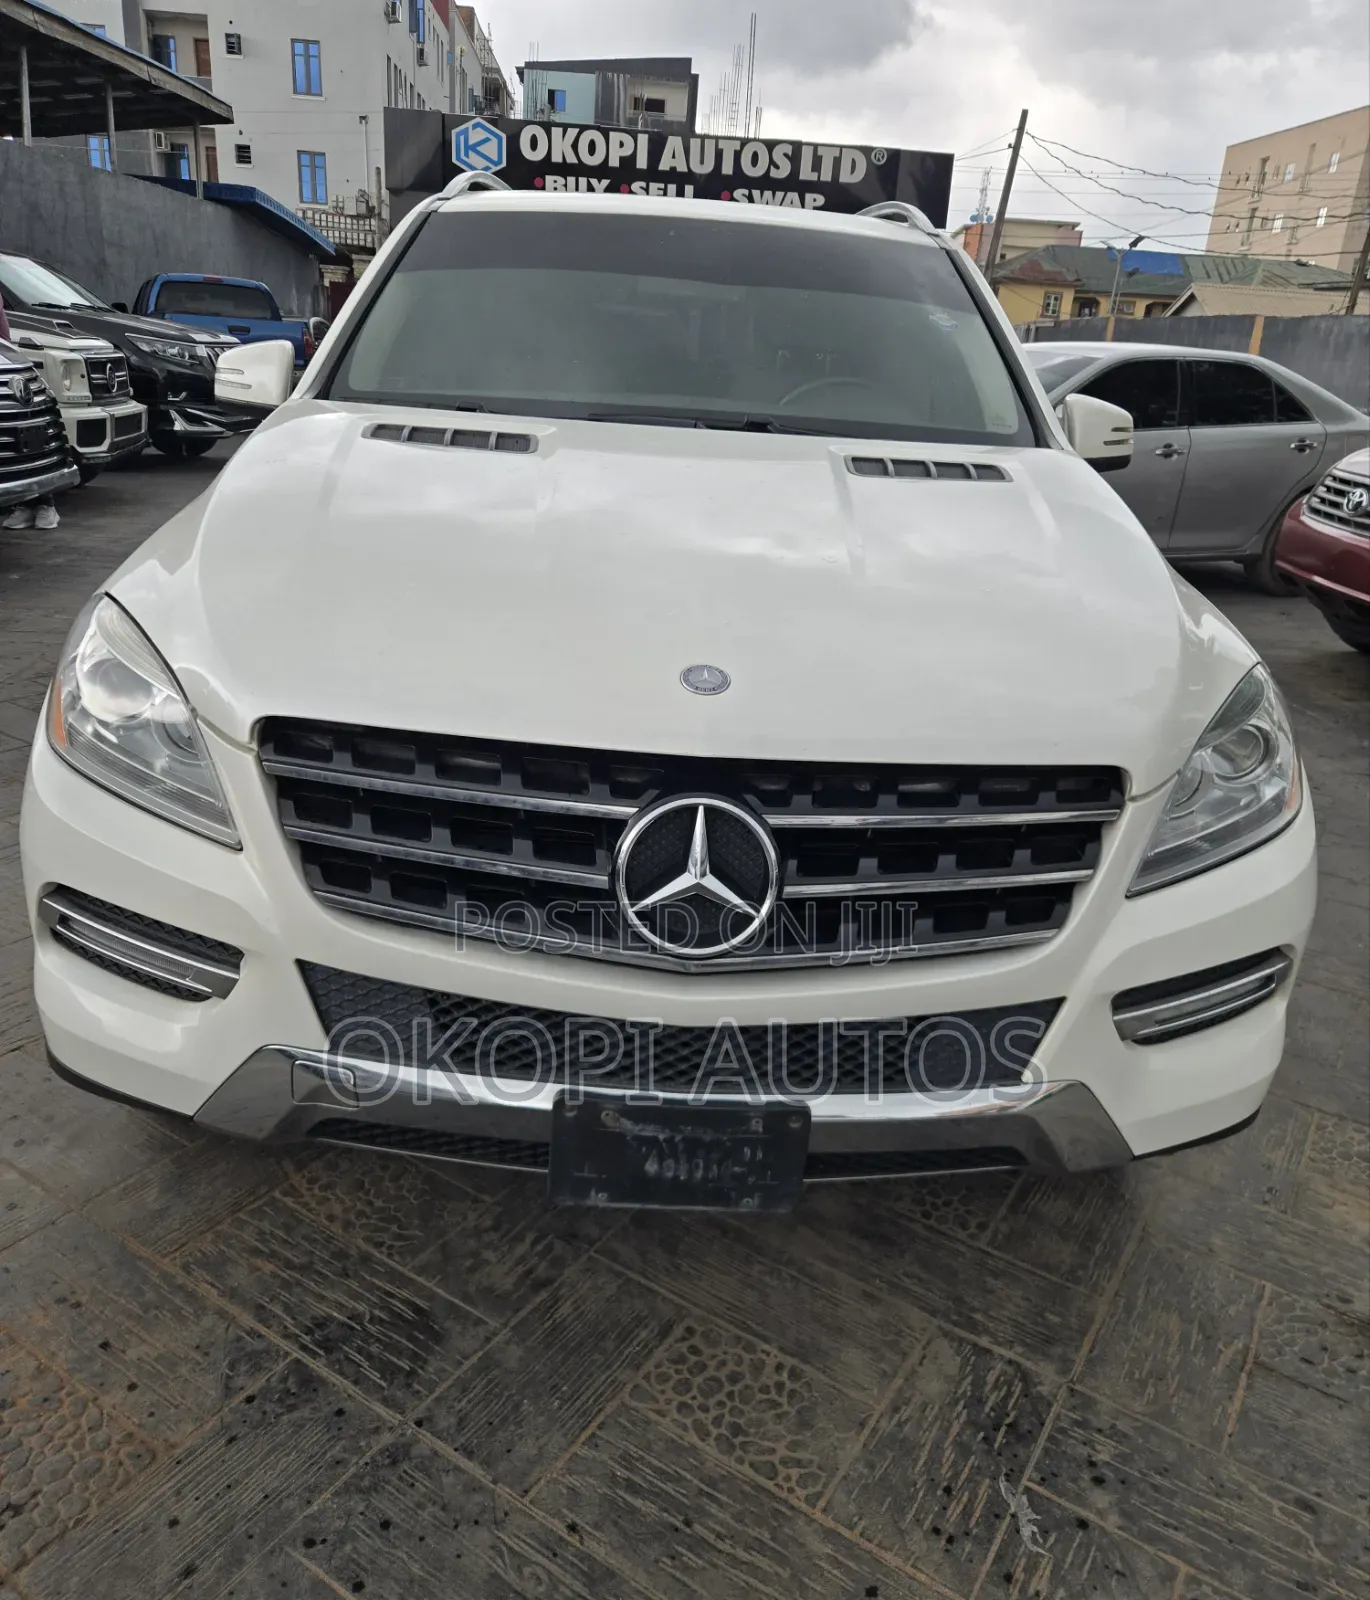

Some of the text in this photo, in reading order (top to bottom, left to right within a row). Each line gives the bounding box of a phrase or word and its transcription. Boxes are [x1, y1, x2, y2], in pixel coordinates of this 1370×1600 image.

[519, 124, 648, 169] OKOPI
[658, 135, 793, 179] AUTOS
[733, 188, 826, 210] SWAP
